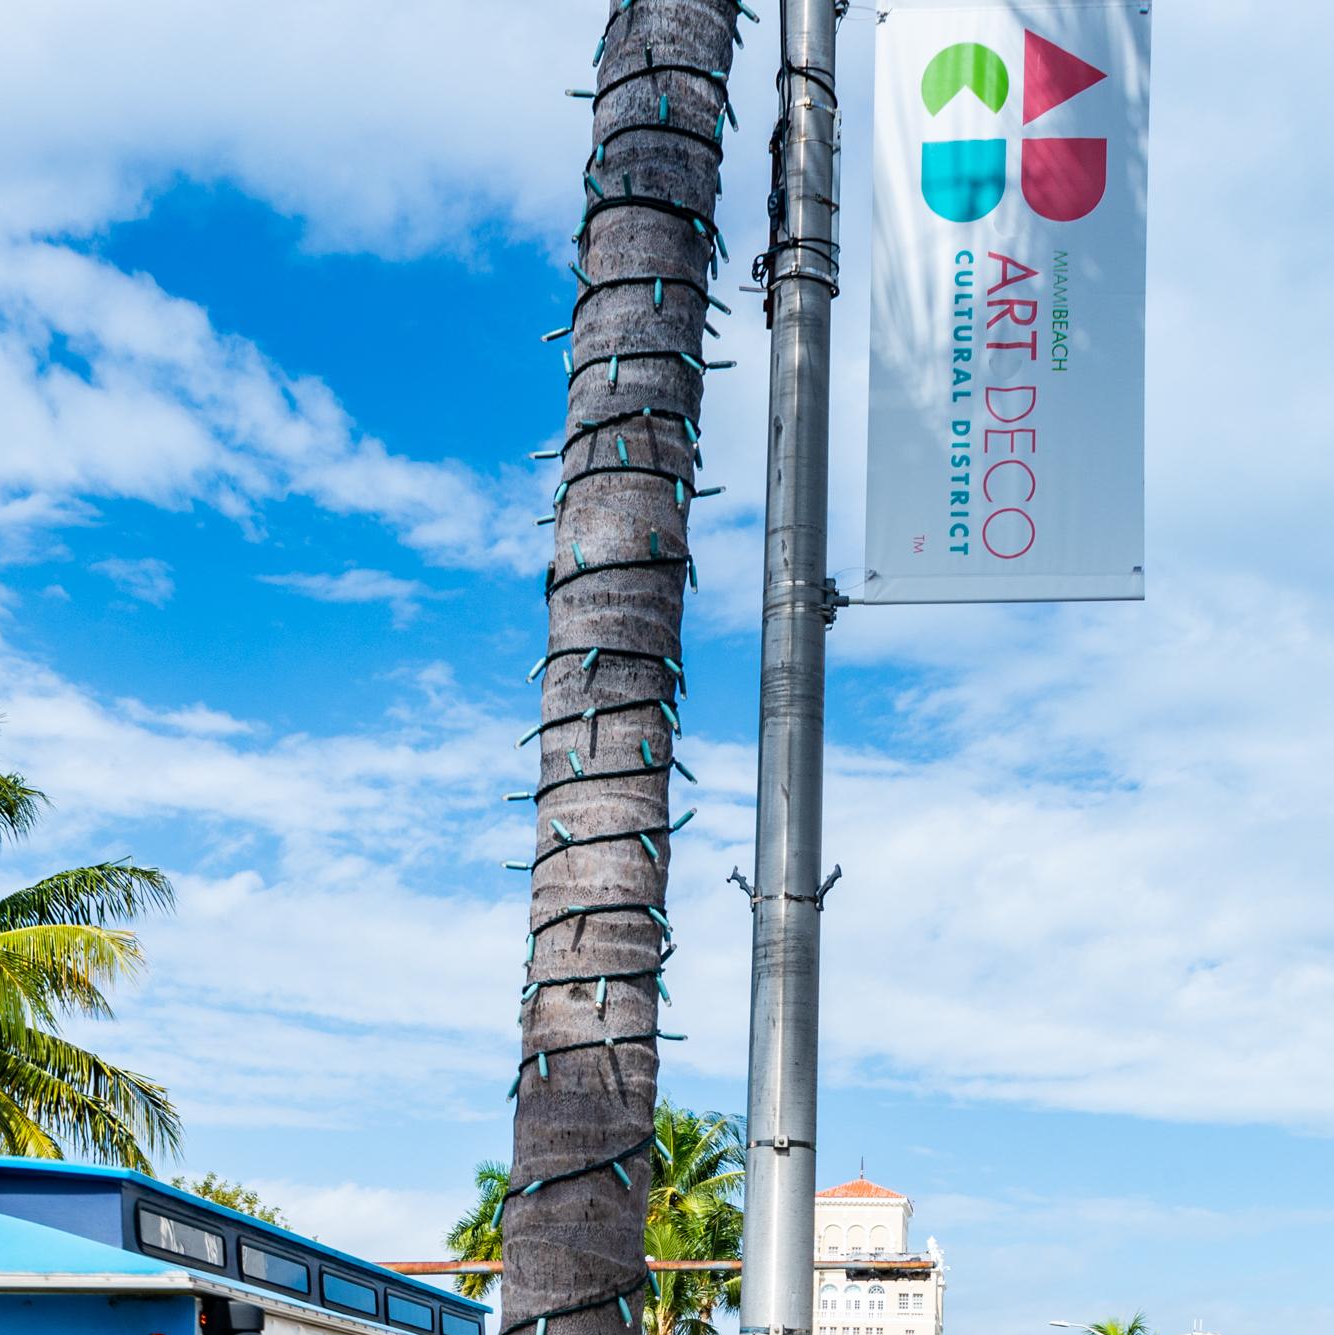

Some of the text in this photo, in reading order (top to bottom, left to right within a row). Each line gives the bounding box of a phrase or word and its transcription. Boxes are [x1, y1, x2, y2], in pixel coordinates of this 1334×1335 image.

[948, 249, 975, 556] CULTURAL DISTRICT
[982, 251, 1040, 560] ART DECO
